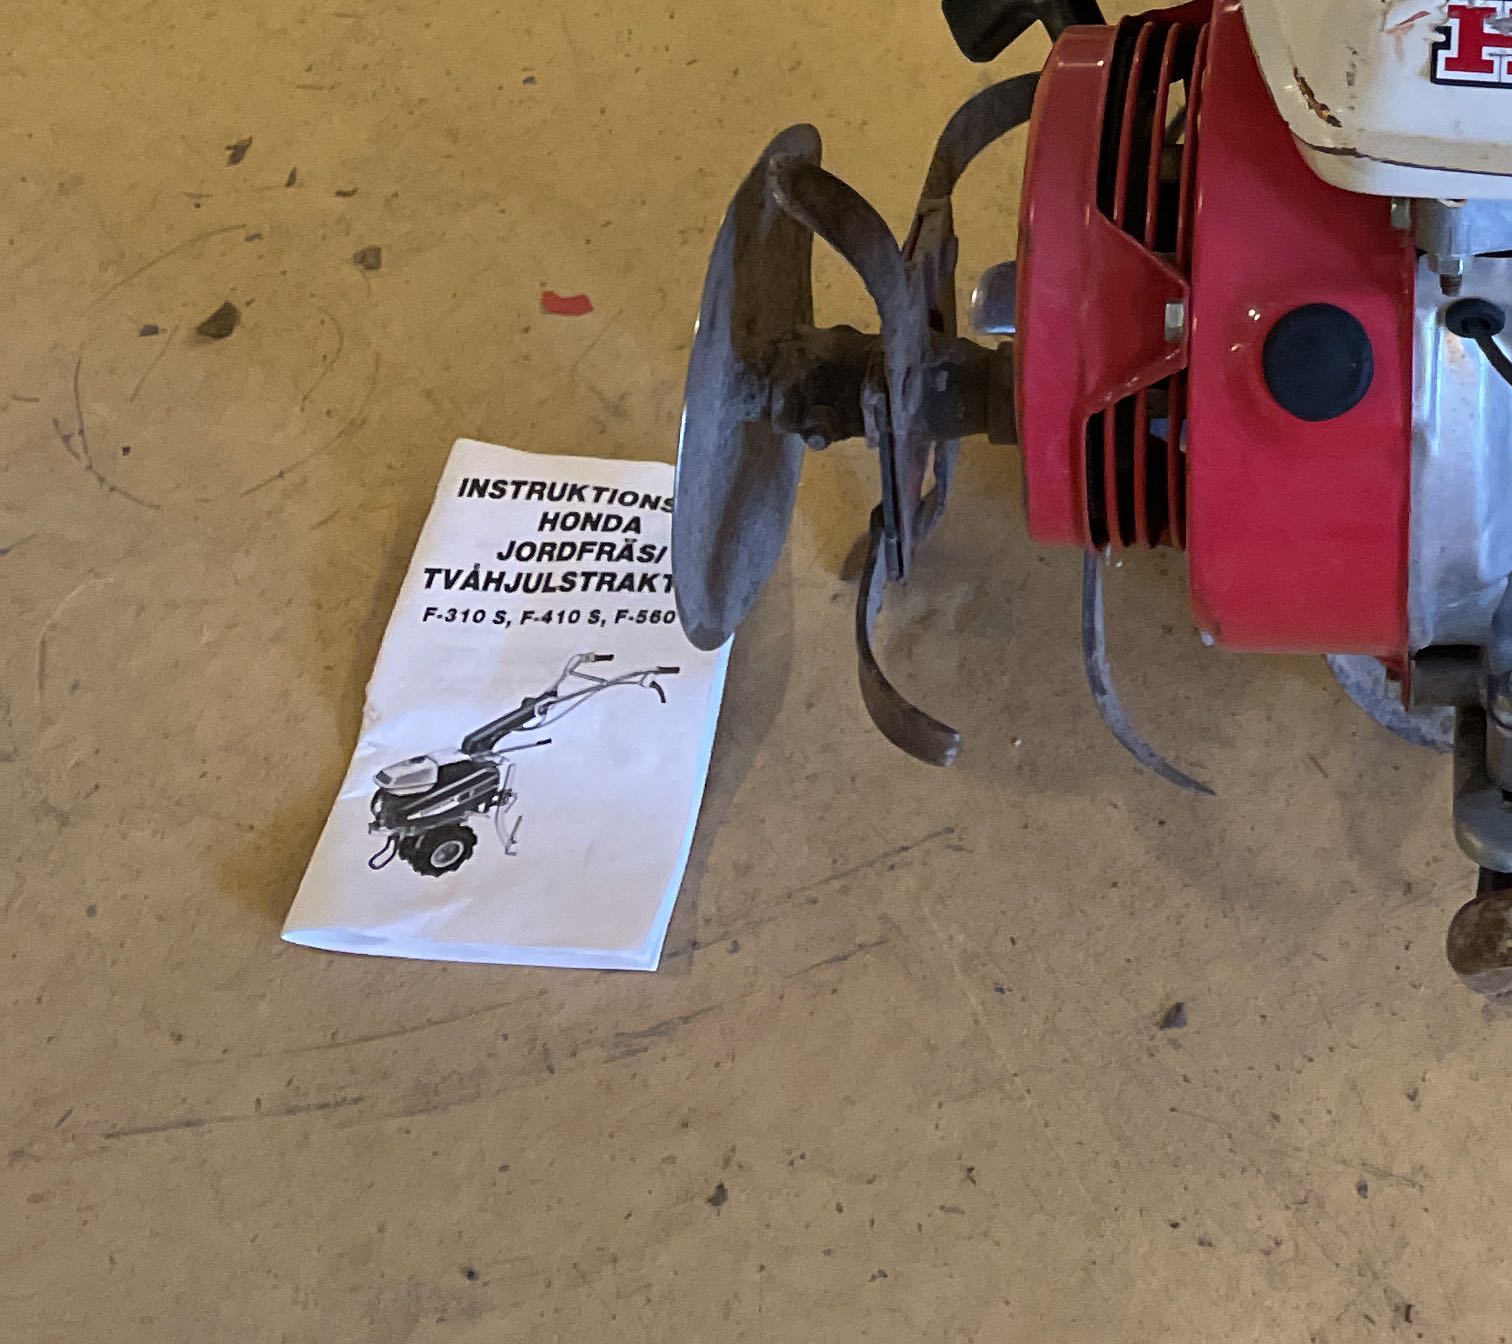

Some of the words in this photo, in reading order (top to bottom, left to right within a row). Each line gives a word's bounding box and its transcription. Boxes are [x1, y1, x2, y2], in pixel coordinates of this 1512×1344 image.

[537, 512, 642, 534] HONDA
[496, 538, 668, 564] JORDFRÄS/
[422, 607, 486, 624] F-310
[492, 610, 512, 628] S,
[520, 610, 581, 625] F-410
[587, 610, 606, 628] S,
